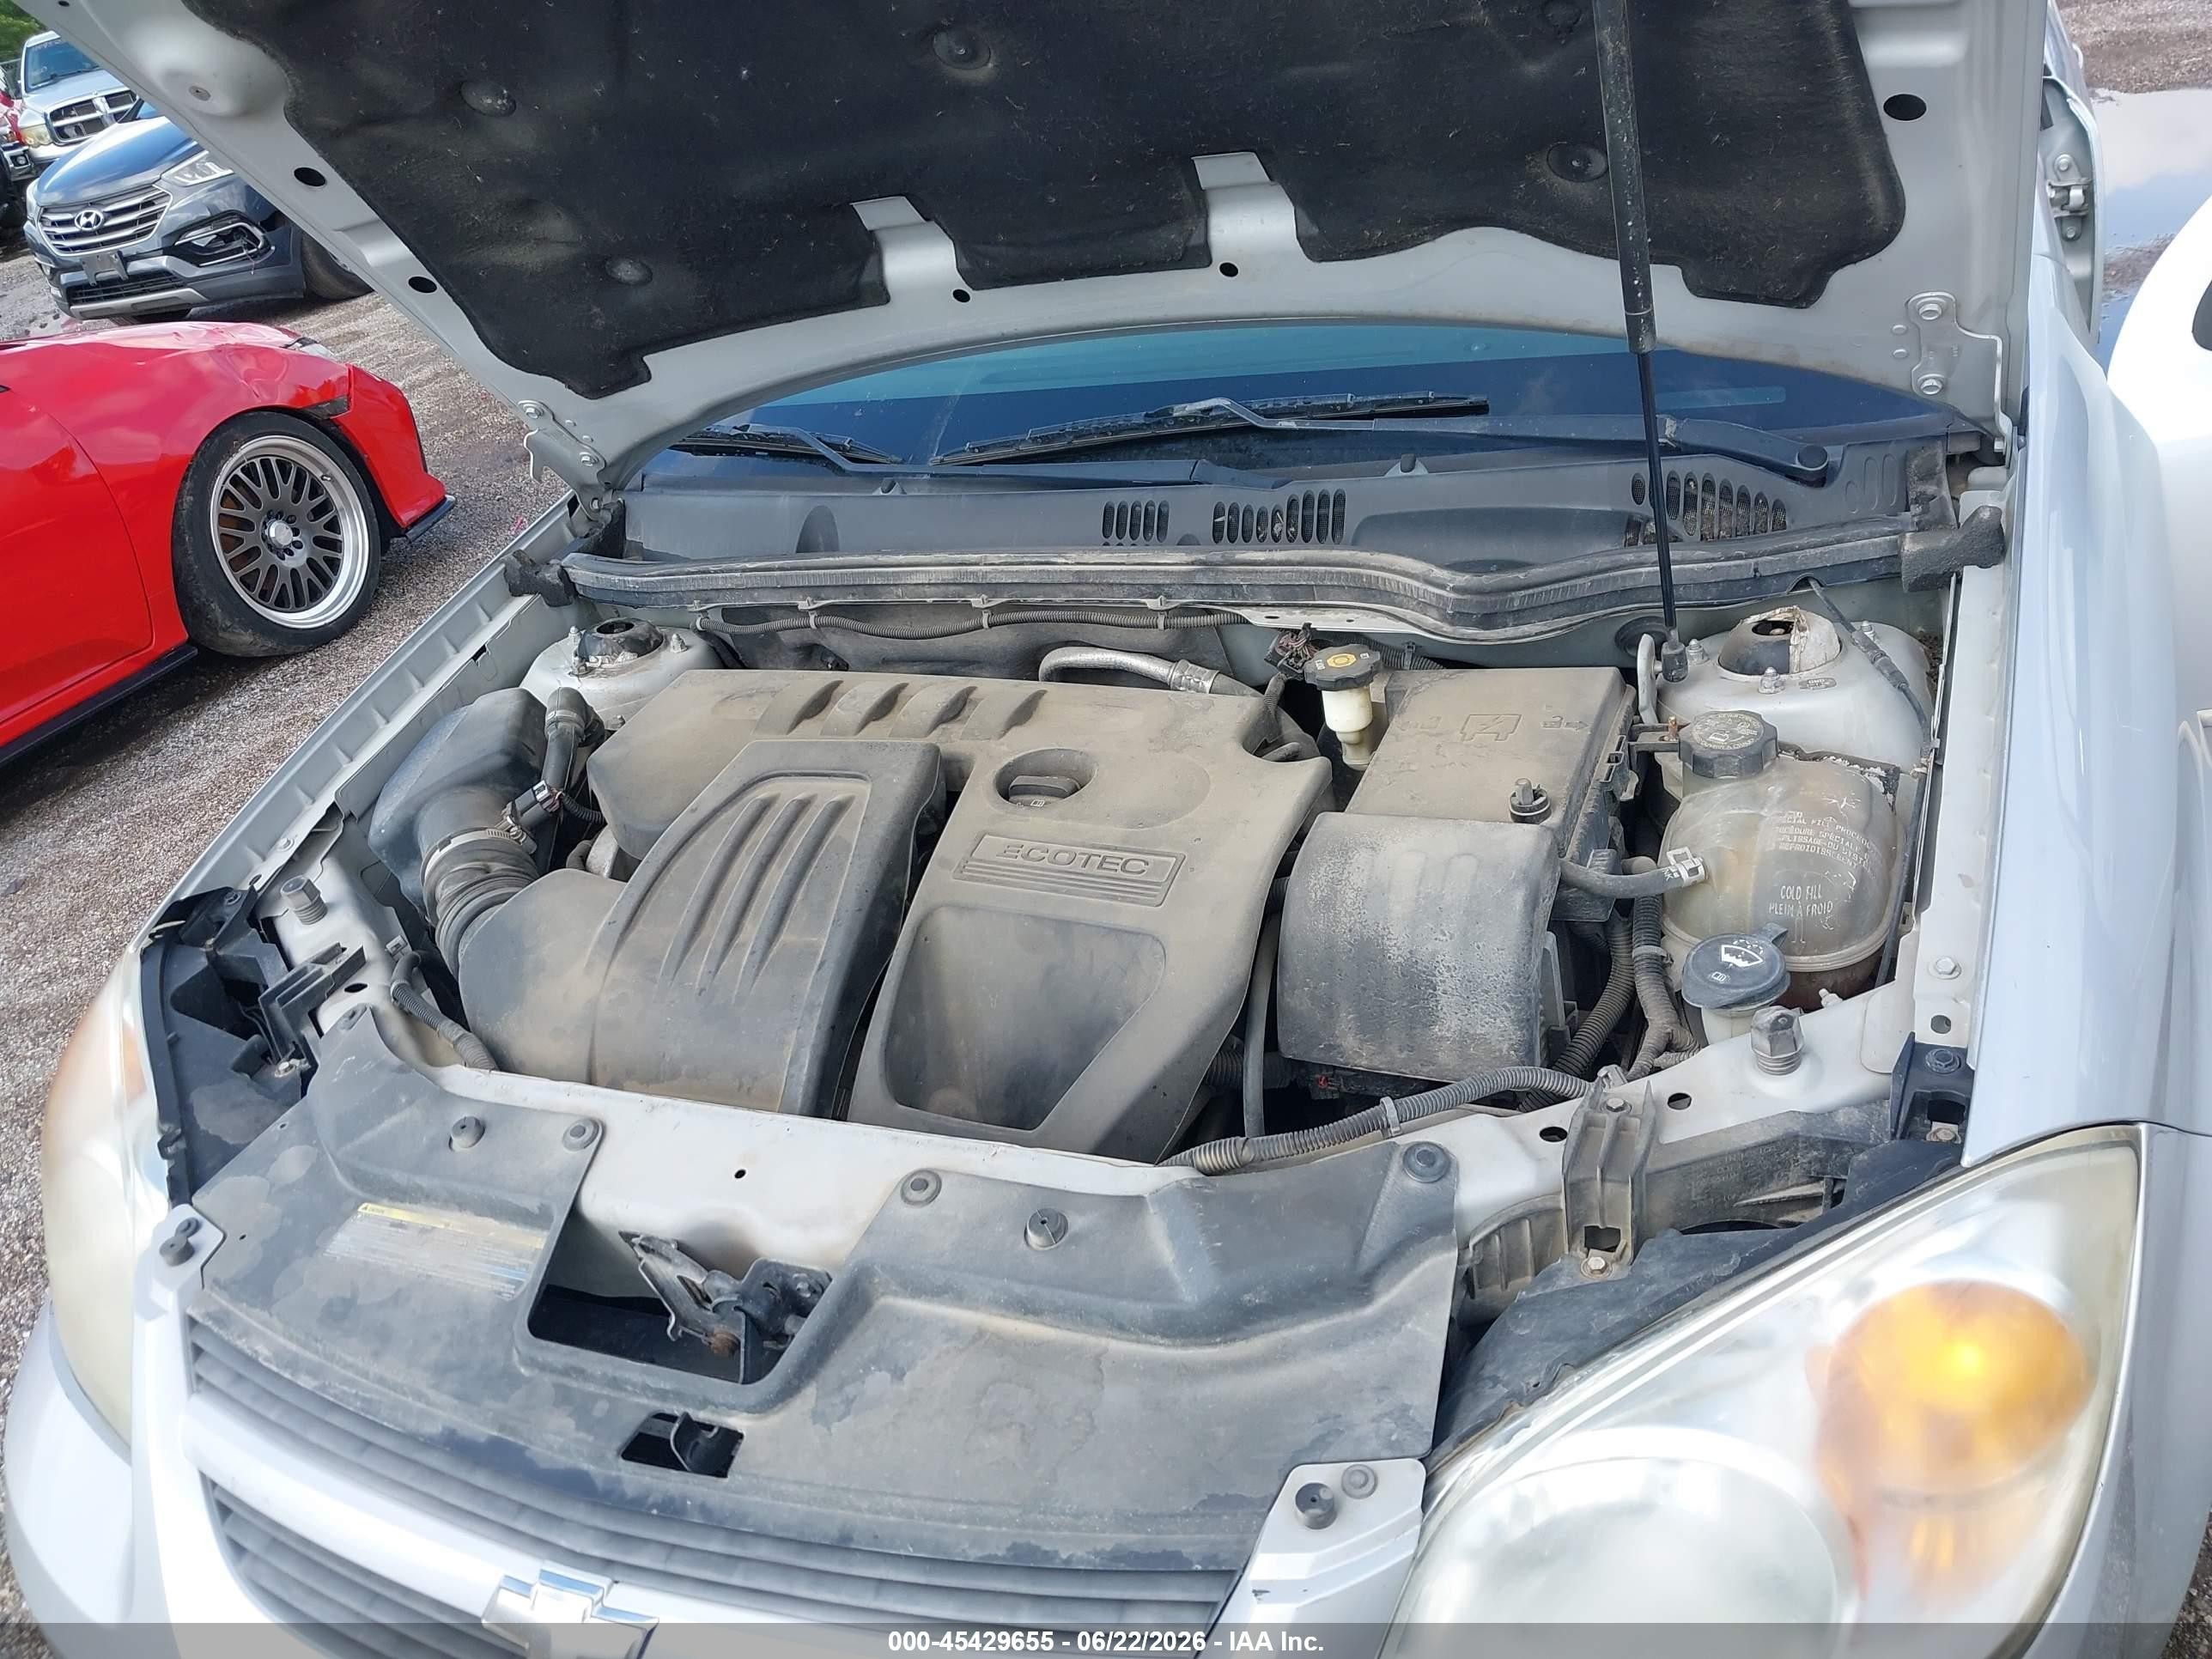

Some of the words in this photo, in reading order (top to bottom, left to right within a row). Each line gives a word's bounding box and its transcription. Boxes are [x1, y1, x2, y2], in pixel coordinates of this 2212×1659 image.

[996, 843, 1150, 877] ECOTEC
[1780, 885, 1802, 901] COLD
[1806, 883, 1822, 900] FILL
[1769, 902, 1795, 917] PLEIN
[1806, 900, 1833, 917] FROID
